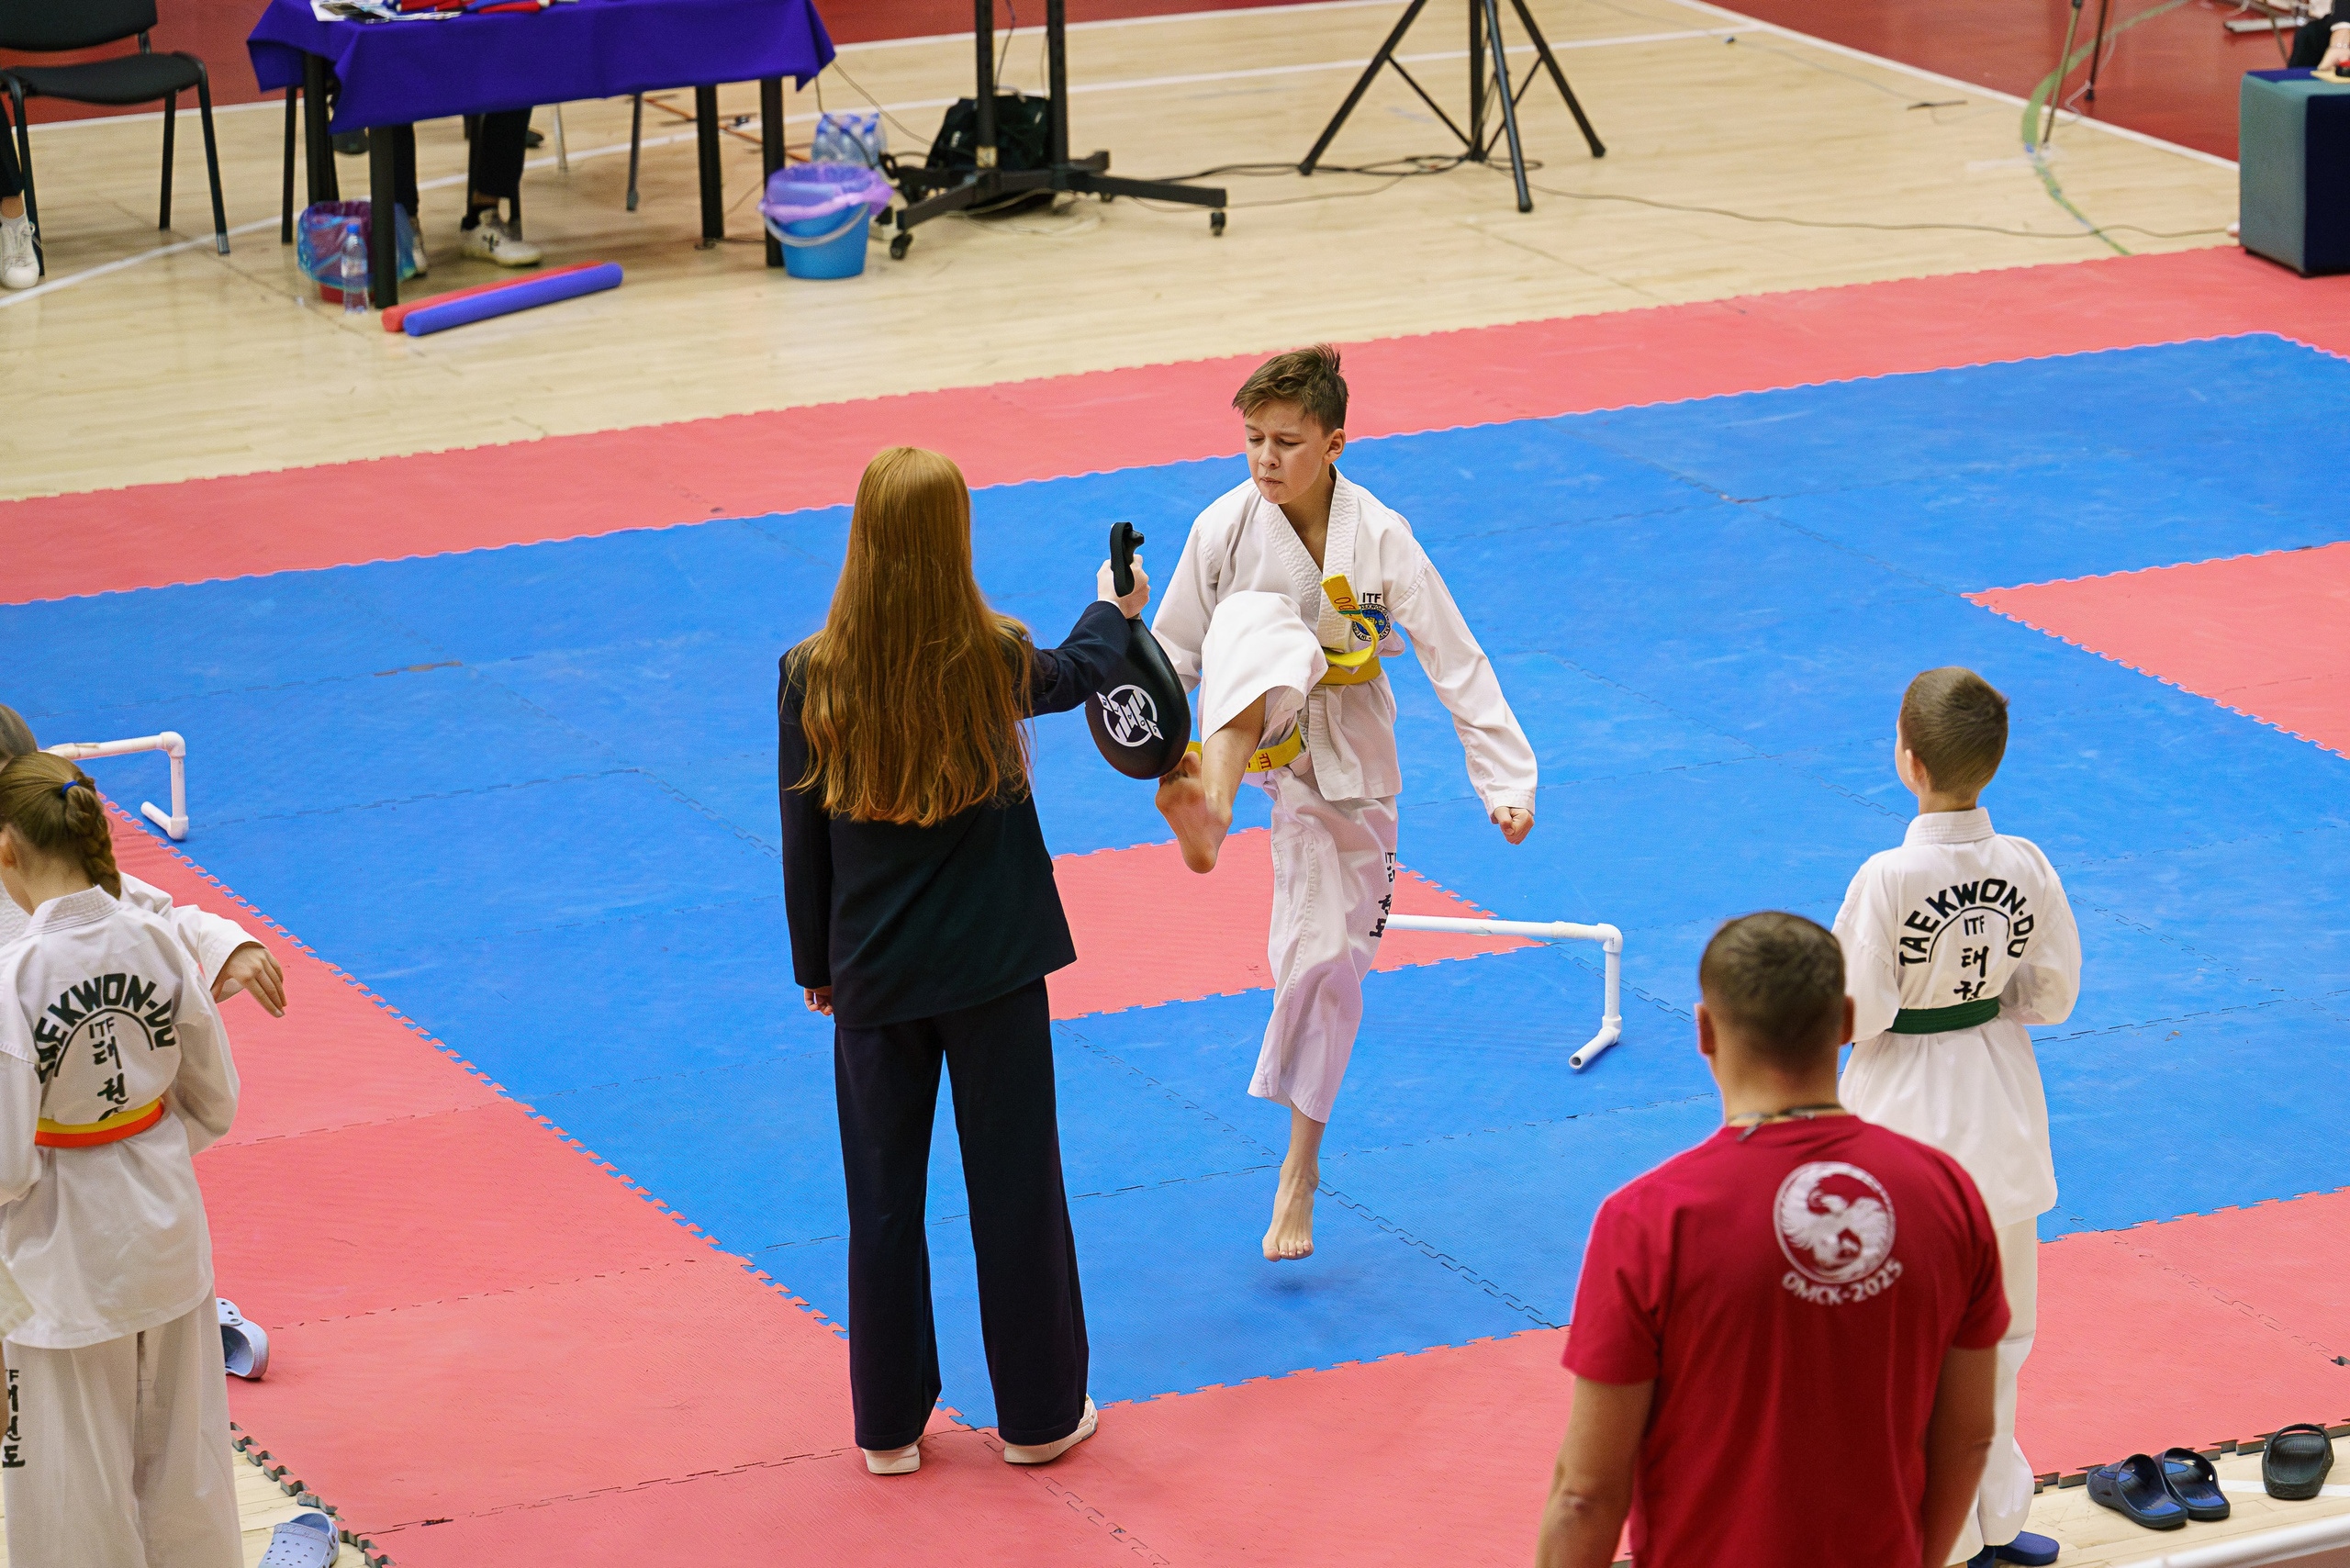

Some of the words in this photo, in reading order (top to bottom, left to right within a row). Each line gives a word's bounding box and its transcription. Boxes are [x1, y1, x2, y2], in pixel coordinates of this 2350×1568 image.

[1362, 592, 1382, 603] ITF
[1899, 878, 2035, 968] TAEKWON-DO
[1964, 914, 1986, 936] ITF
[88, 1015, 115, 1039] ITF
